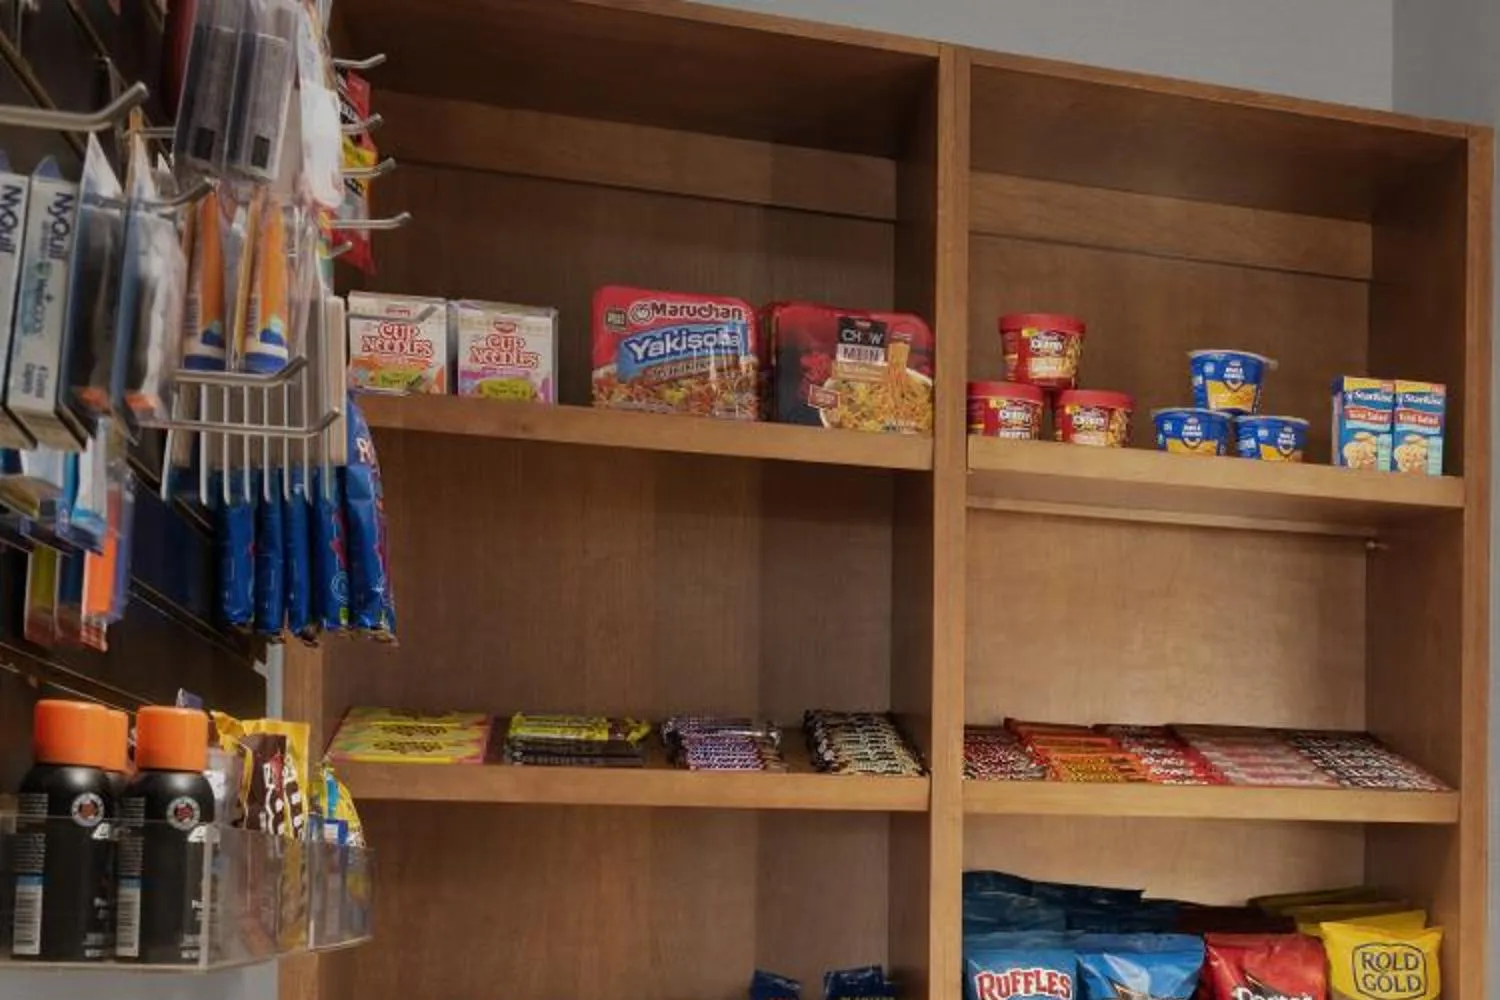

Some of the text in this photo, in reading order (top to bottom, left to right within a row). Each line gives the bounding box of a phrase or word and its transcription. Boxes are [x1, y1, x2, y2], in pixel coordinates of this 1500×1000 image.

[47, 191, 74, 260] NyQuil
[651, 302, 742, 320] Maruchan
[377, 322, 419, 340] CUP
[841, 328, 884, 345] CHW
[362, 335, 433, 357] NOODLES
[485, 334, 524, 350] CUP
[625, 327, 739, 362] Yakisoba
[470, 347, 540, 368] NOODLES
[1361, 951, 1420, 971] ROLD
[1362, 972, 1423, 993] GOLD
